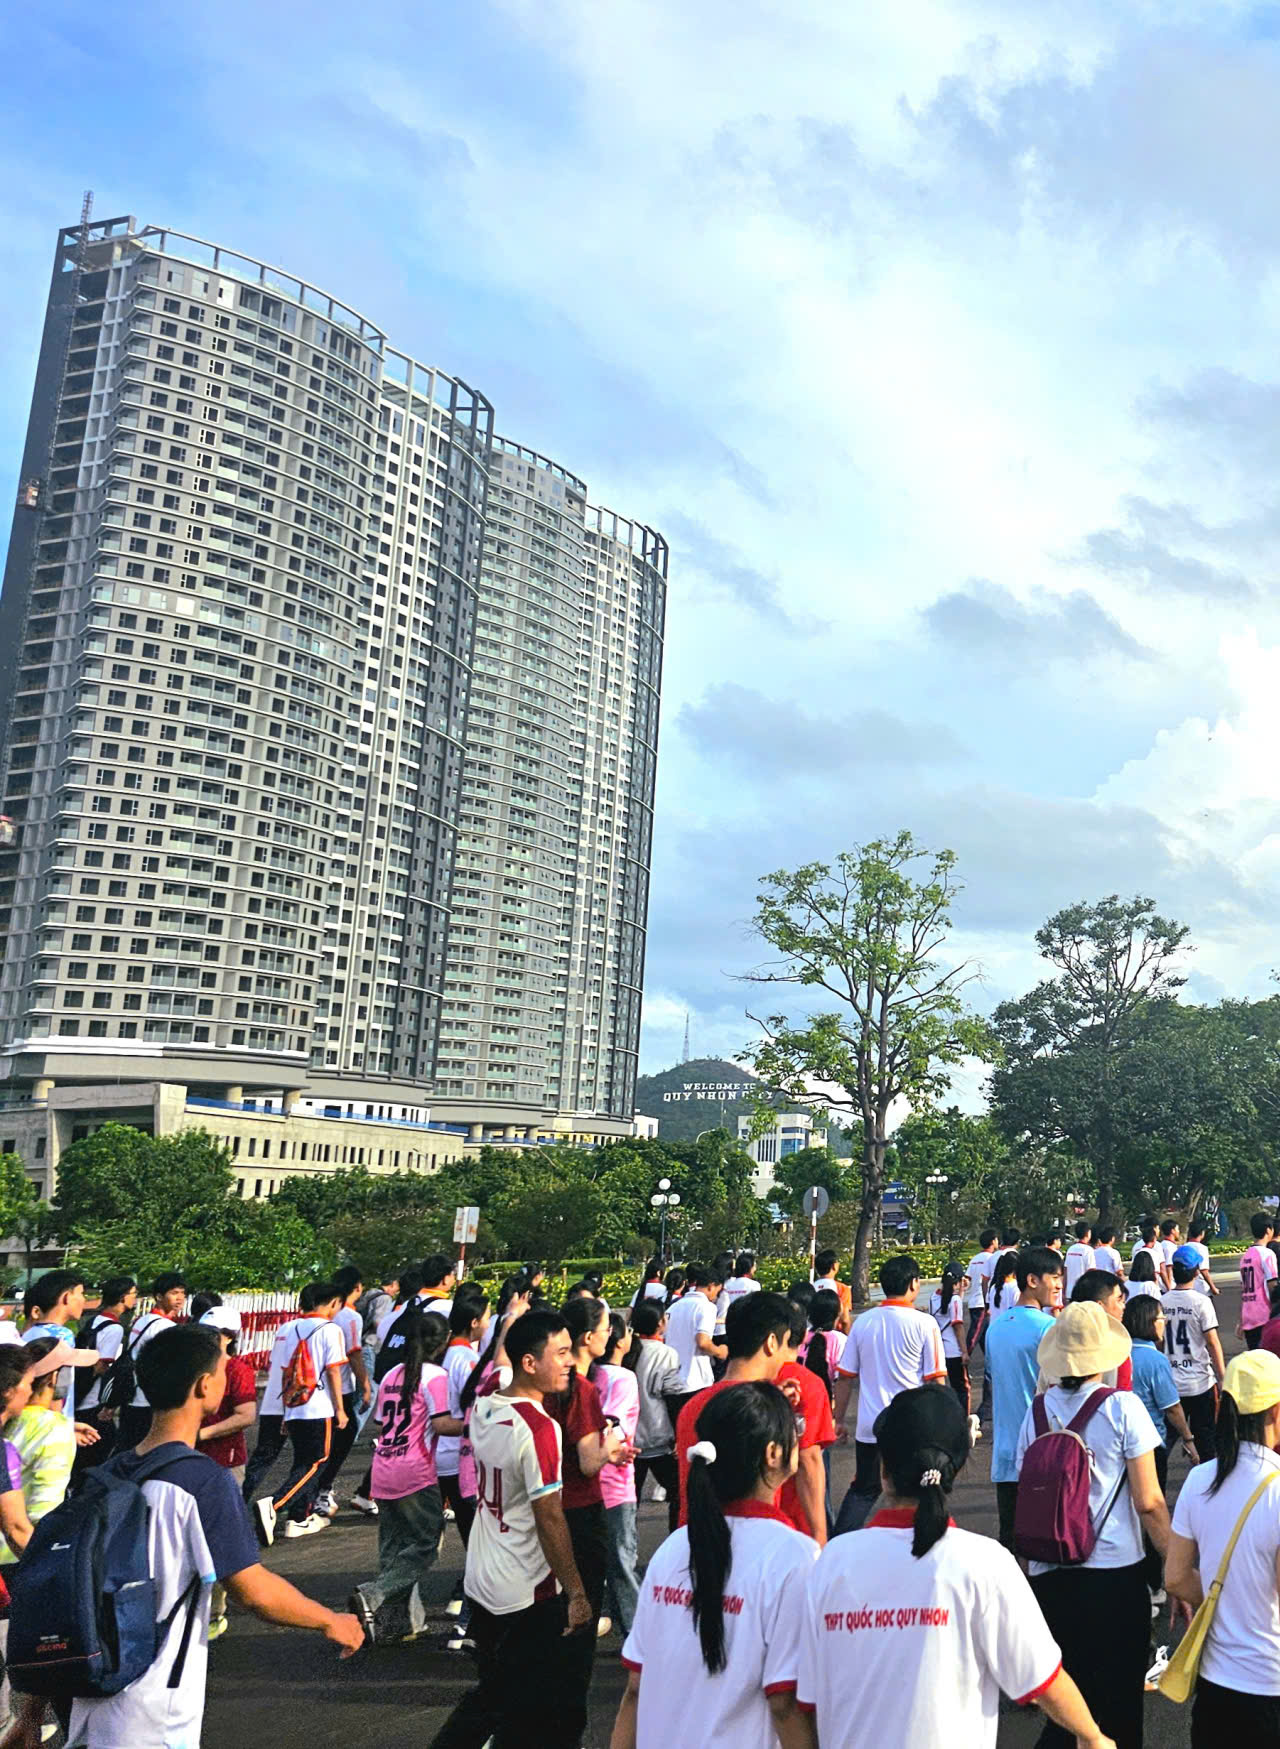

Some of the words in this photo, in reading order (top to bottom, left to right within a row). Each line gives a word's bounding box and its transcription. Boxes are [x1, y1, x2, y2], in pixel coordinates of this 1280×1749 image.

[663, 1091, 693, 1103] QUY
[683, 1082, 740, 1091] WELCOME
[1165, 1319, 1192, 1355] 14
[382, 1400, 412, 1447] 22
[846, 1602, 873, 1634] QUỐC
[875, 1608, 895, 1633] HỌC
[896, 1607, 918, 1631] QUY
